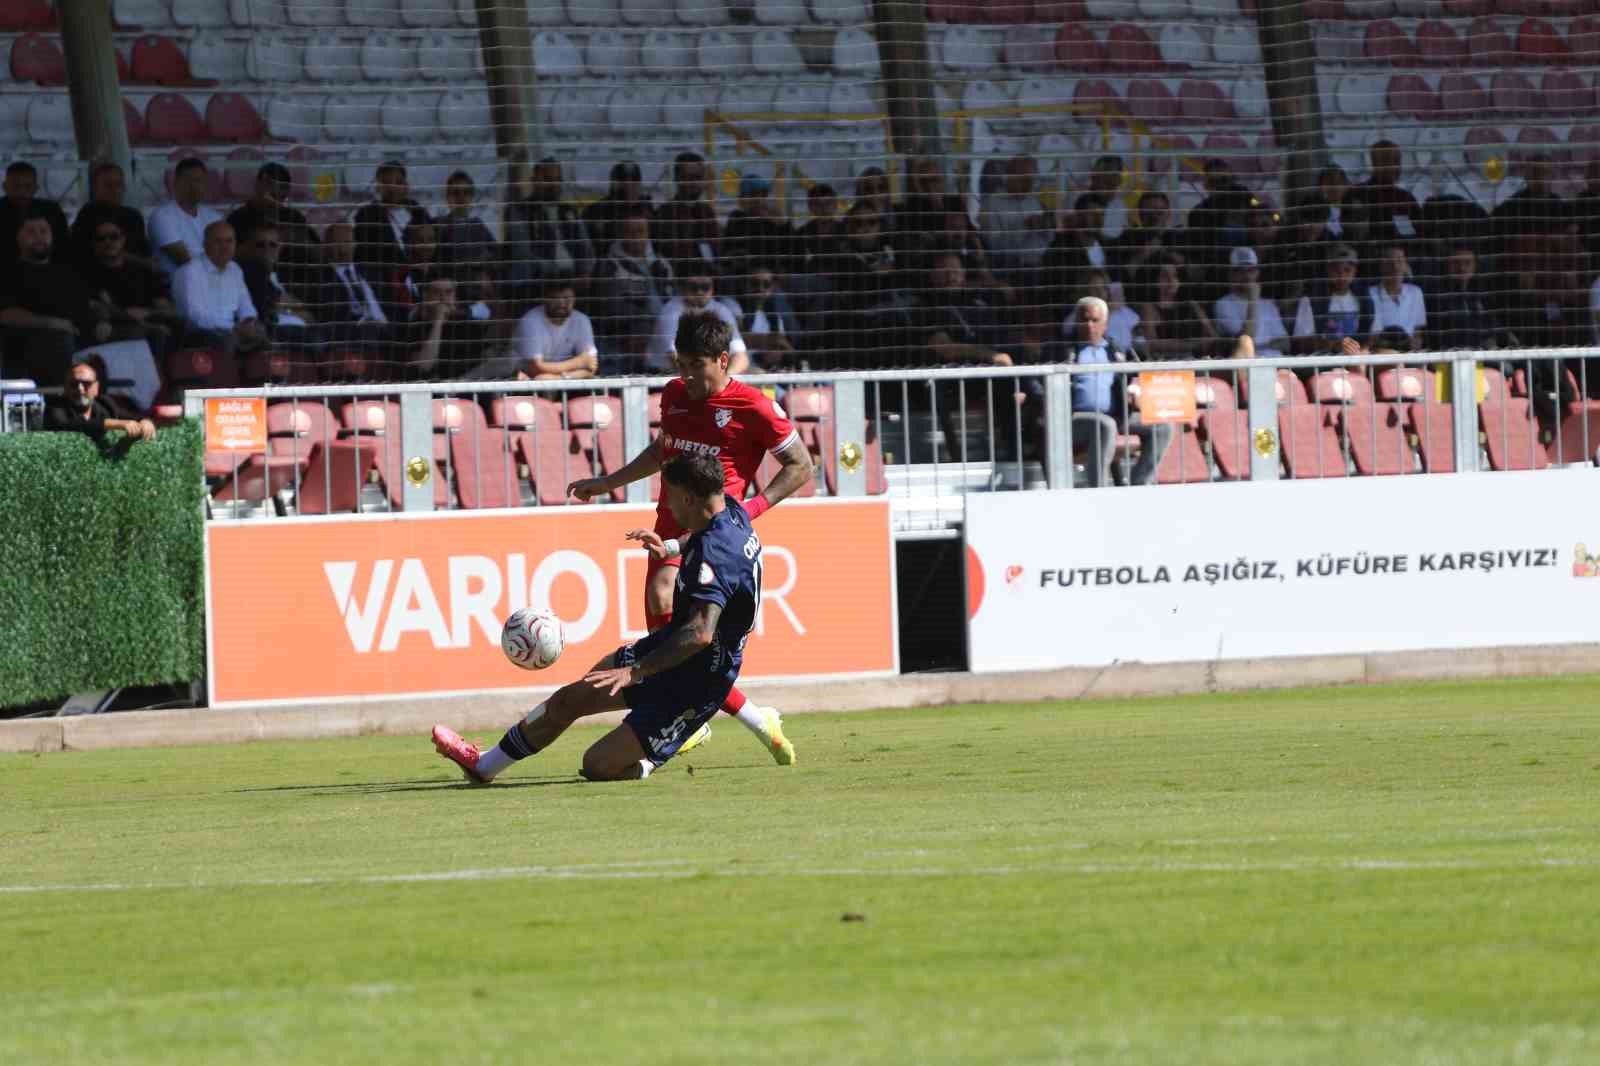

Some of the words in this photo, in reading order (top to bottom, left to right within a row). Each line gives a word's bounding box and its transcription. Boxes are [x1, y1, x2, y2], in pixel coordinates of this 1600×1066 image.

[673, 438, 721, 456] METRO
[1039, 565, 1172, 588] FUTBOLA
[1182, 556, 1286, 586] AŞIĞIZ,
[1295, 552, 1409, 578] KÜFÜRE
[1418, 548, 1559, 573] KARŞIYIZ!
